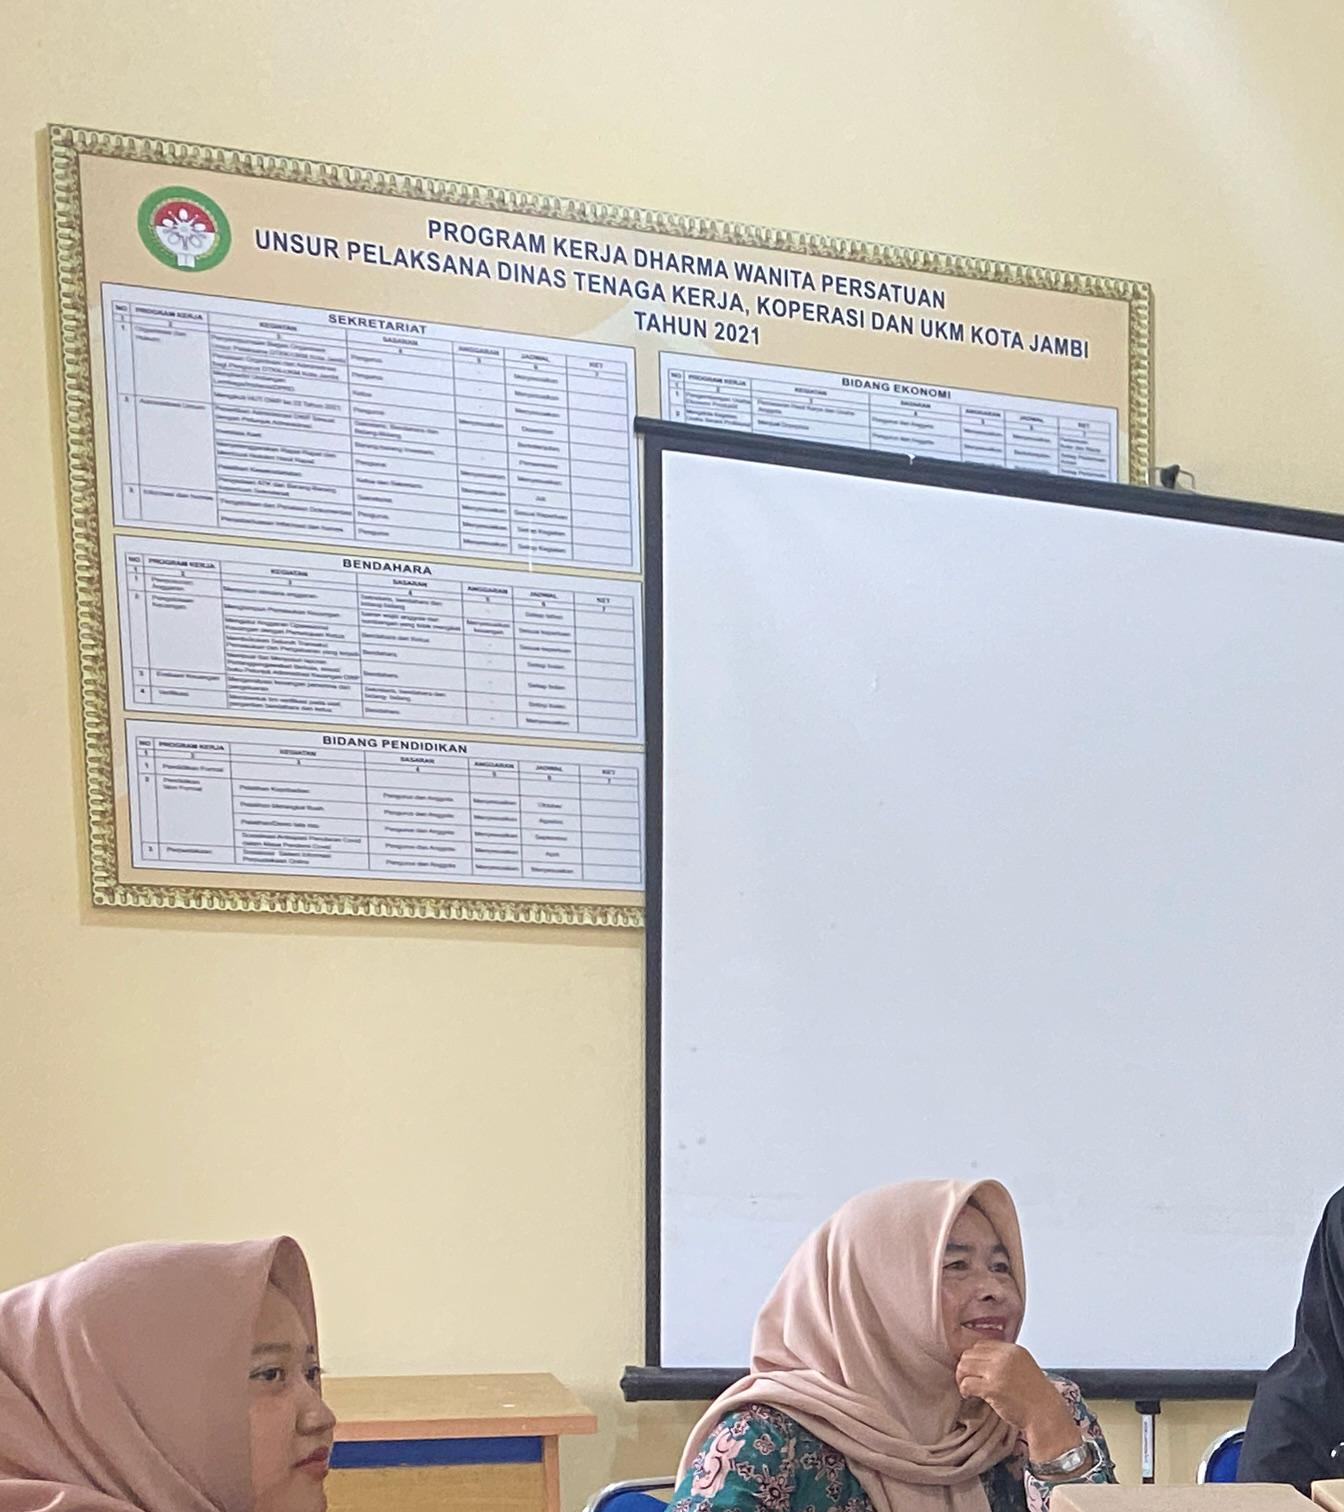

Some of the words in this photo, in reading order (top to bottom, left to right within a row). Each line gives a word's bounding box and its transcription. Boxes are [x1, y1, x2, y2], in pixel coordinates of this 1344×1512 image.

[428, 219, 545, 254] PROGRAM
[553, 237, 625, 264] KERJA
[635, 252, 729, 279] DHARMA
[734, 262, 815, 291] WANITA
[821, 274, 945, 309] PERSATUAN
[255, 228, 339, 259] UNSUR
[347, 241, 491, 278] PELAKSANA
[498, 260, 566, 289] DINAS
[573, 271, 666, 302] TENAGA
[672, 285, 751, 317] KERJA,
[757, 296, 866, 328] KOPERASI
[871, 312, 914, 335] DAN
[920, 319, 964, 342] UKM
[971, 327, 1023, 351] KOTA
[1029, 333, 1088, 358] JAMBI
[328, 313, 427, 335] SEKRETARIAT
[634, 311, 707, 339] TAHUN
[714, 321, 760, 345] 2021
[842, 378, 890, 392] BIDANG
[893, 384, 951, 399] EKONOMI
[343, 558, 432, 575] BENDAHARA
[323, 735, 378, 748] BIDANG
[382, 740, 467, 753] PENDIDIKAN
